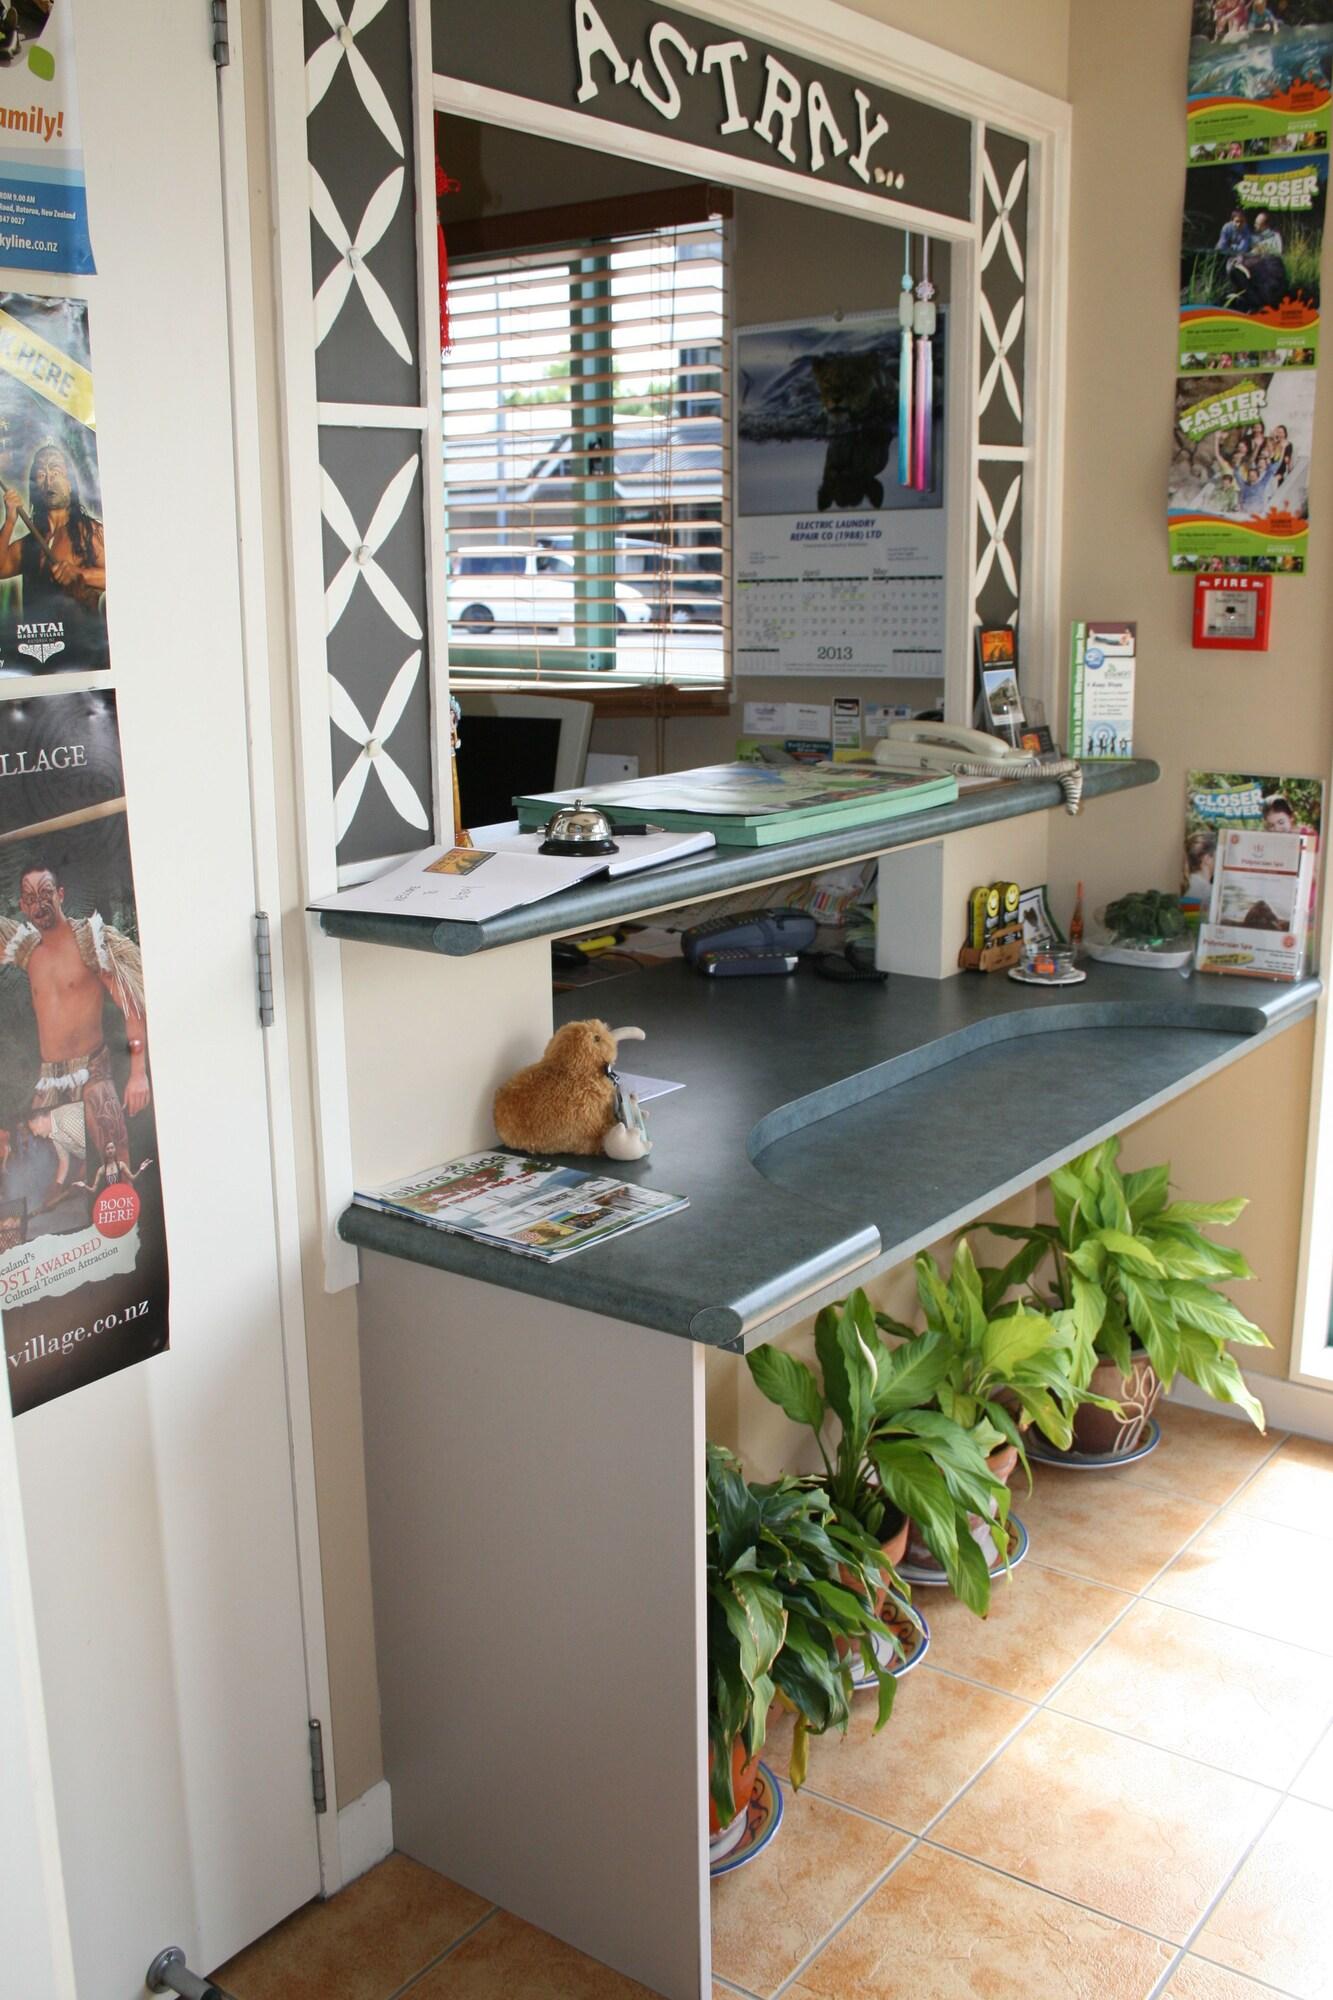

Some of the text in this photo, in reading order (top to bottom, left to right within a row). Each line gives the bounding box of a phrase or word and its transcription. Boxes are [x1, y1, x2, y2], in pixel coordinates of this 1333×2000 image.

[1237, 176, 1319, 196] CLOSER
[1269, 194, 1313, 208] EVER
[17, 343, 76, 398] HERE
[1180, 389, 1268, 433] FASTER
[1220, 407, 1260, 426] EVER
[796, 518, 876, 530] ELECTRIC LAUNDRY
[790, 532, 819, 541] REPAIR
[821, 531, 833, 540] CO
[866, 530, 882, 539] LTD
[1214, 578, 1248, 588] FIRE
[17, 622, 64, 634] MITAI
[817, 646, 853, 661] 2013
[0, 744, 88, 777] LLAGE
[1194, 788, 1265, 807] CLOSER
[1224, 804, 1262, 816] EVER
[453, 1154, 507, 1178] guide
[100, 1197, 135, 1212] BOOK
[98, 1208, 135, 1225] HERE
[34, 1238, 102, 1280] AWARDED
[4, 1246, 119, 1304] Cultural Tourism Attraction
[8, 1300, 150, 1368] village.co.nz
